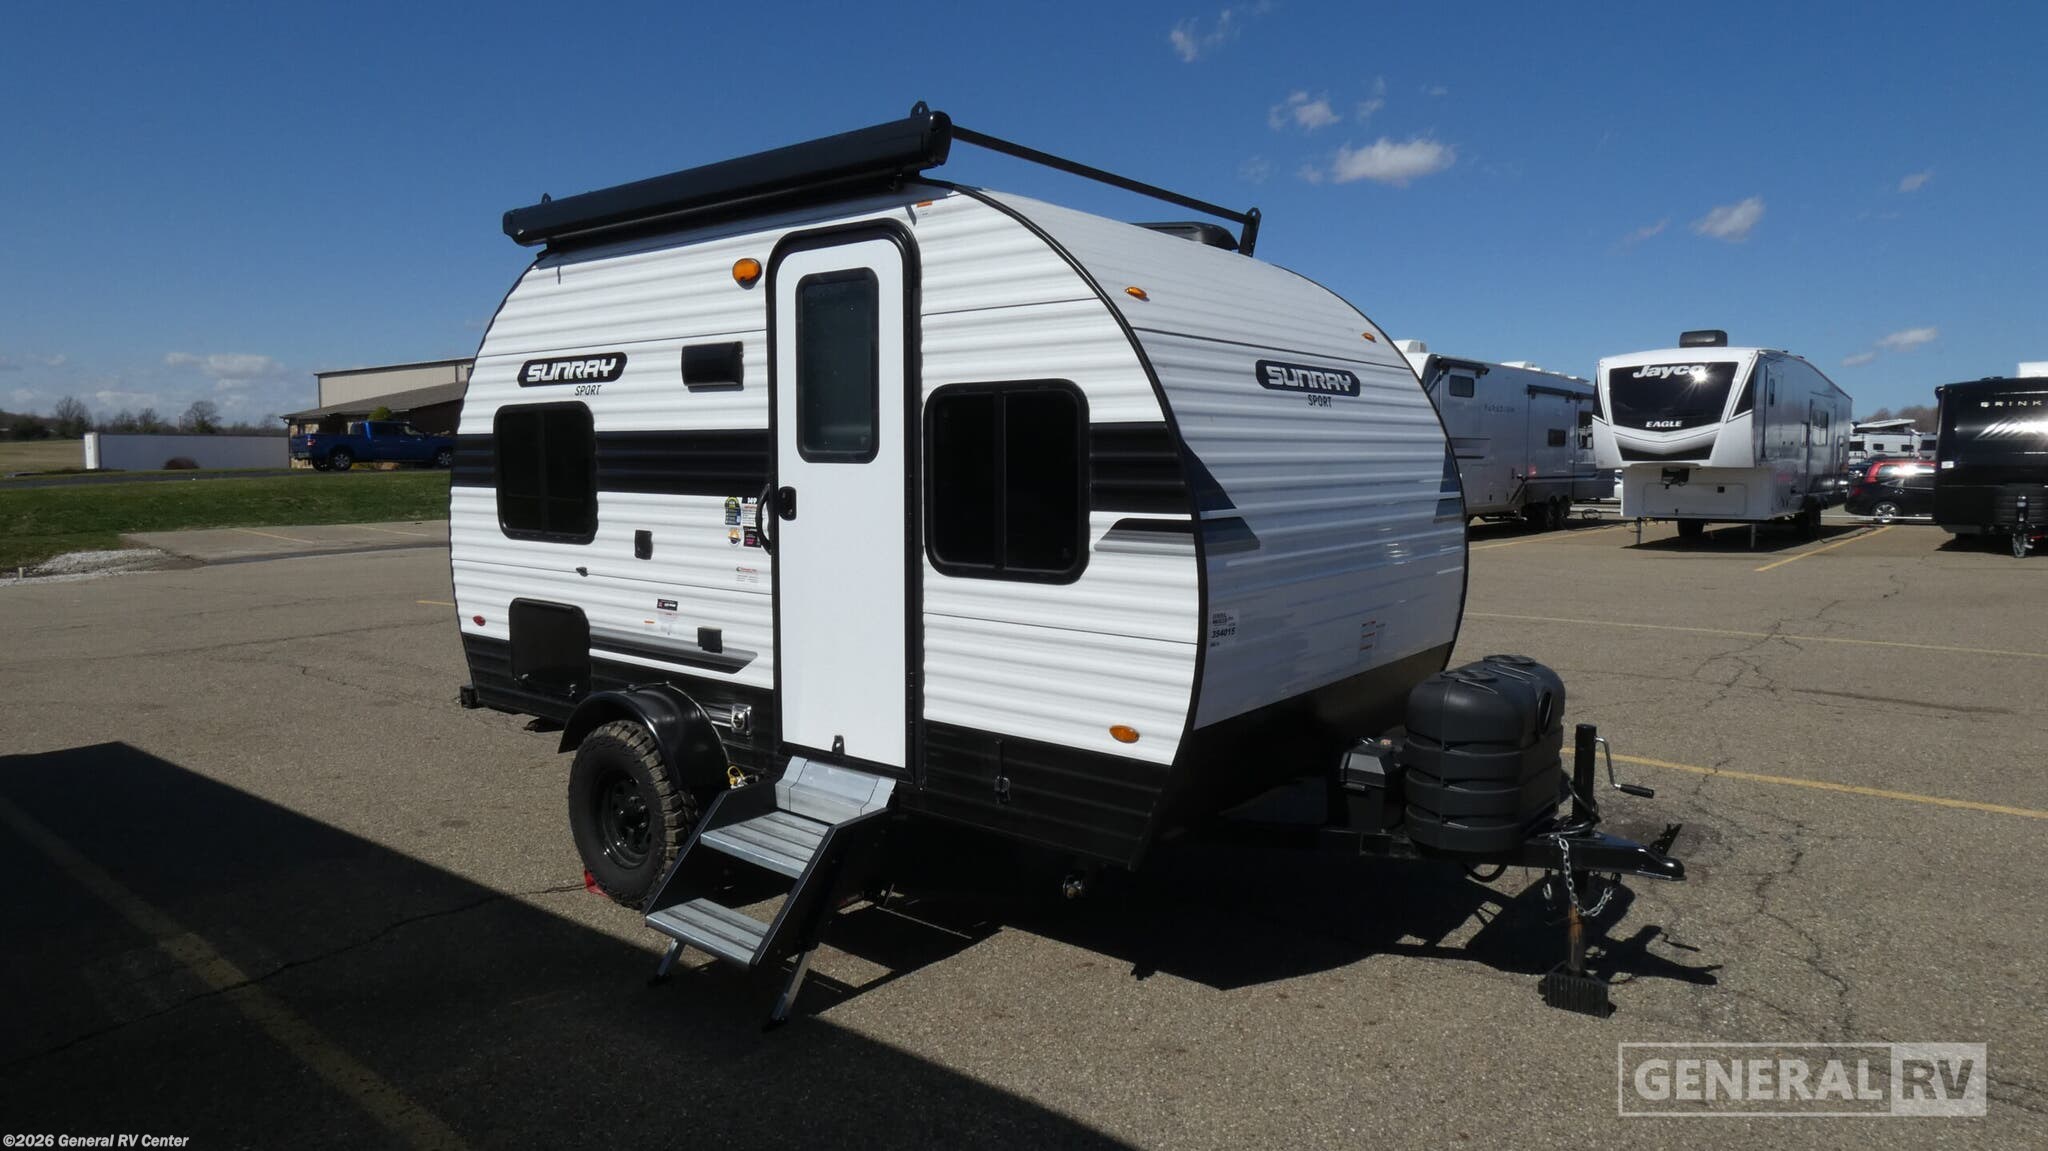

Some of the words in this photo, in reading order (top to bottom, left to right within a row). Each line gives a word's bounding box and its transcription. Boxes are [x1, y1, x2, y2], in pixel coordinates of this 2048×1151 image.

[527, 358, 617, 382] SUNRAY
[1632, 365, 1706, 379] Jayco
[1266, 365, 1352, 392] SUNRAY
[575, 385, 602, 396] SPORT
[1308, 394, 1332, 408] SPORT
[1646, 420, 1682, 428] EAGLE
